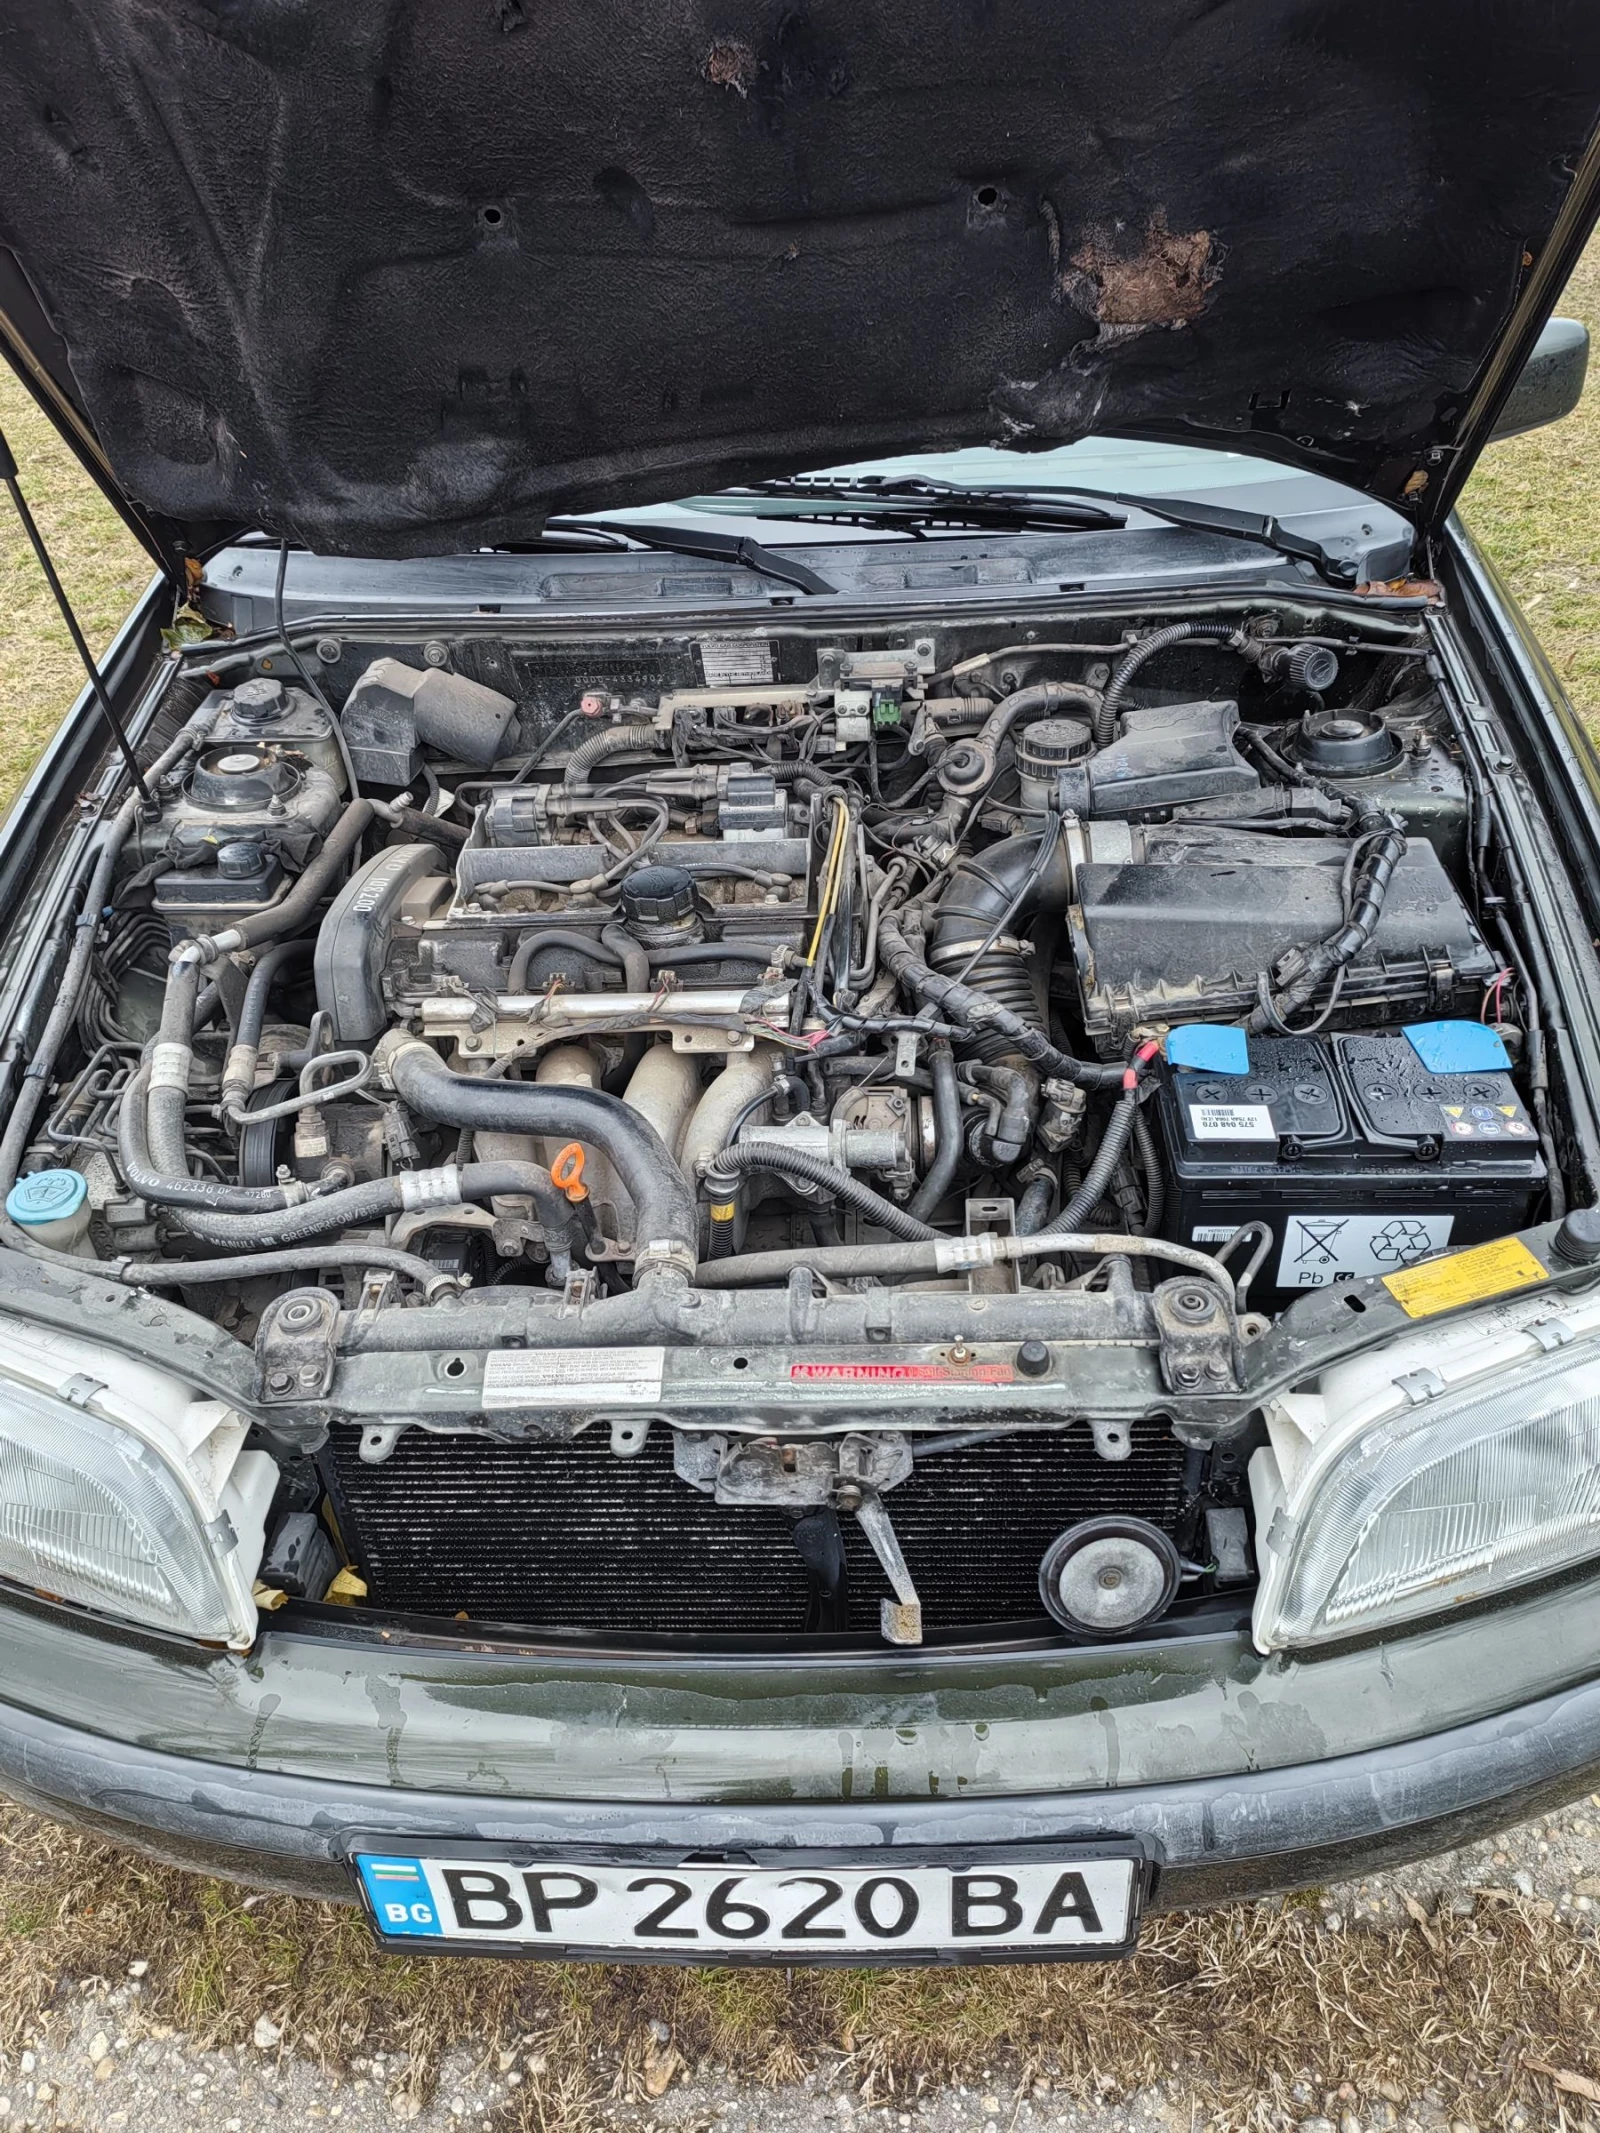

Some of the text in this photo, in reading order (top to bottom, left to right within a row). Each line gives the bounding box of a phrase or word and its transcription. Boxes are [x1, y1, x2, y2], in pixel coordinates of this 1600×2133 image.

[126, 1161, 161, 1188] VOLVO
[1298, 1271, 1324, 1285] Pb
[811, 1366, 906, 1379] WARNING
[990, 1367, 1011, 1376] Fan
[384, 1903, 433, 1923] BG
[441, 1868, 1103, 1940] BP 2620 BA
